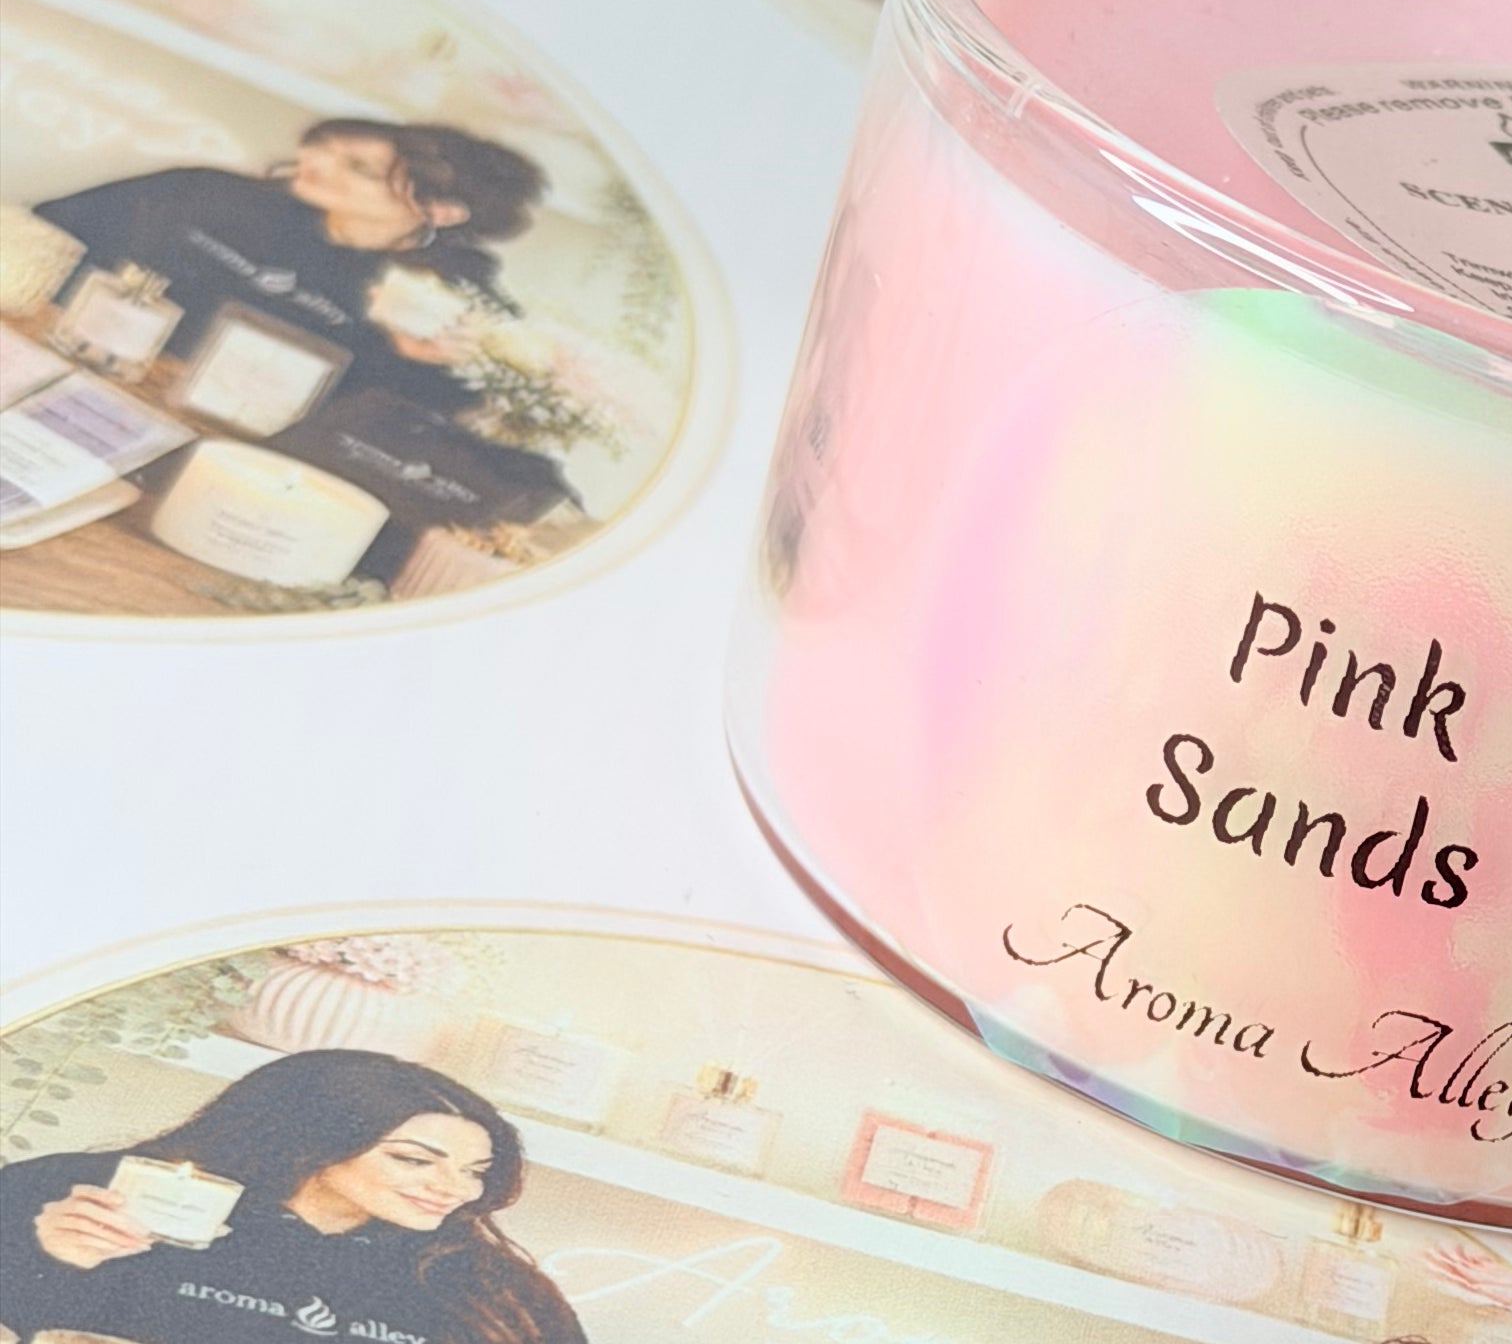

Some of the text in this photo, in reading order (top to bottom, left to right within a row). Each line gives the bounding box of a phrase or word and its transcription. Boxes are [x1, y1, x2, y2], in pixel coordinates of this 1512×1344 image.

[1378, 96, 1503, 112] remove
[1229, 590, 1467, 763] Pink
[1145, 733, 1479, 909] Sands
[1002, 902, 1276, 1059] Aroma
[177, 1281, 288, 1318] aroma
